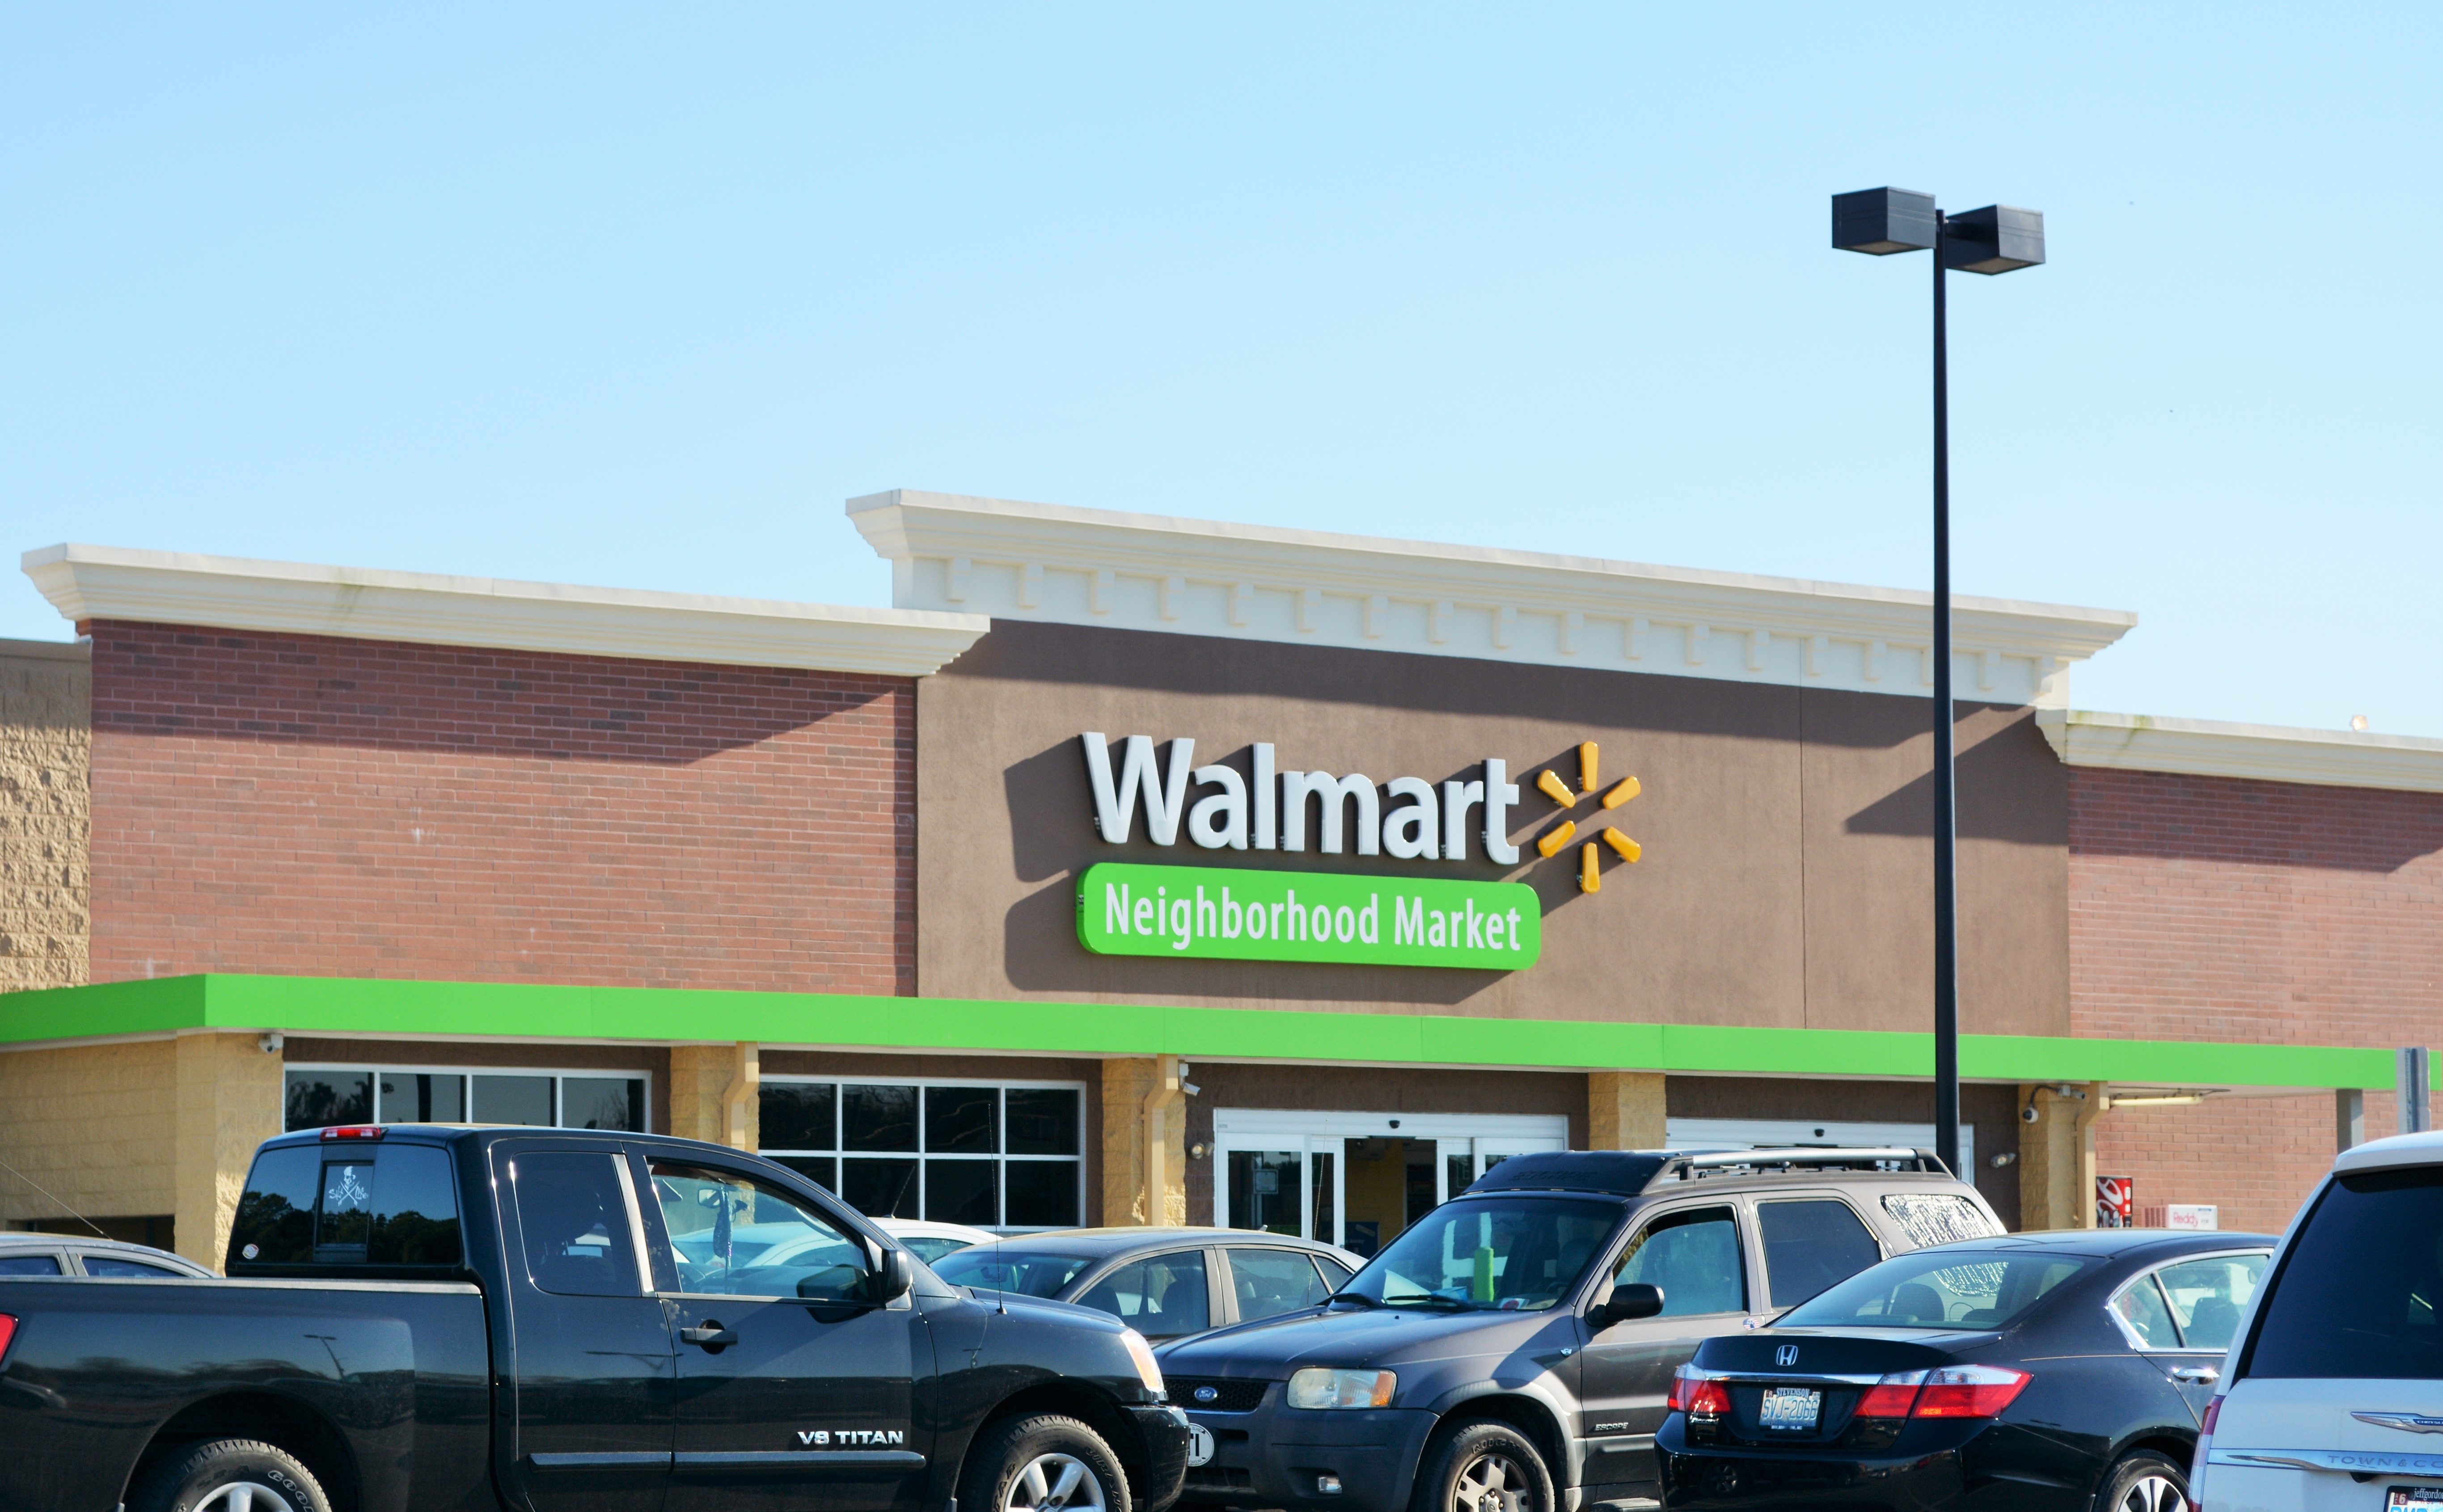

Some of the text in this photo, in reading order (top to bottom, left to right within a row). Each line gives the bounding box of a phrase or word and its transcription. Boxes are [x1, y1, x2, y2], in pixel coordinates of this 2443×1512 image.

[1081, 731, 1519, 865] Walmart
[1105, 882, 1521, 951] Neighborhood Market
[1776, 1388, 1810, 1398] STEVENSON
[1763, 1398, 1818, 1420] SVJ-2066
[1596, 1422, 1629, 1431] ESCAPE
[798, 1431, 903, 1445] V8 TITAN
[2328, 1455, 2392, 1466] TOWN
[2397, 1459, 2408, 1467] &
[2399, 1494, 2406, 1504] 6
